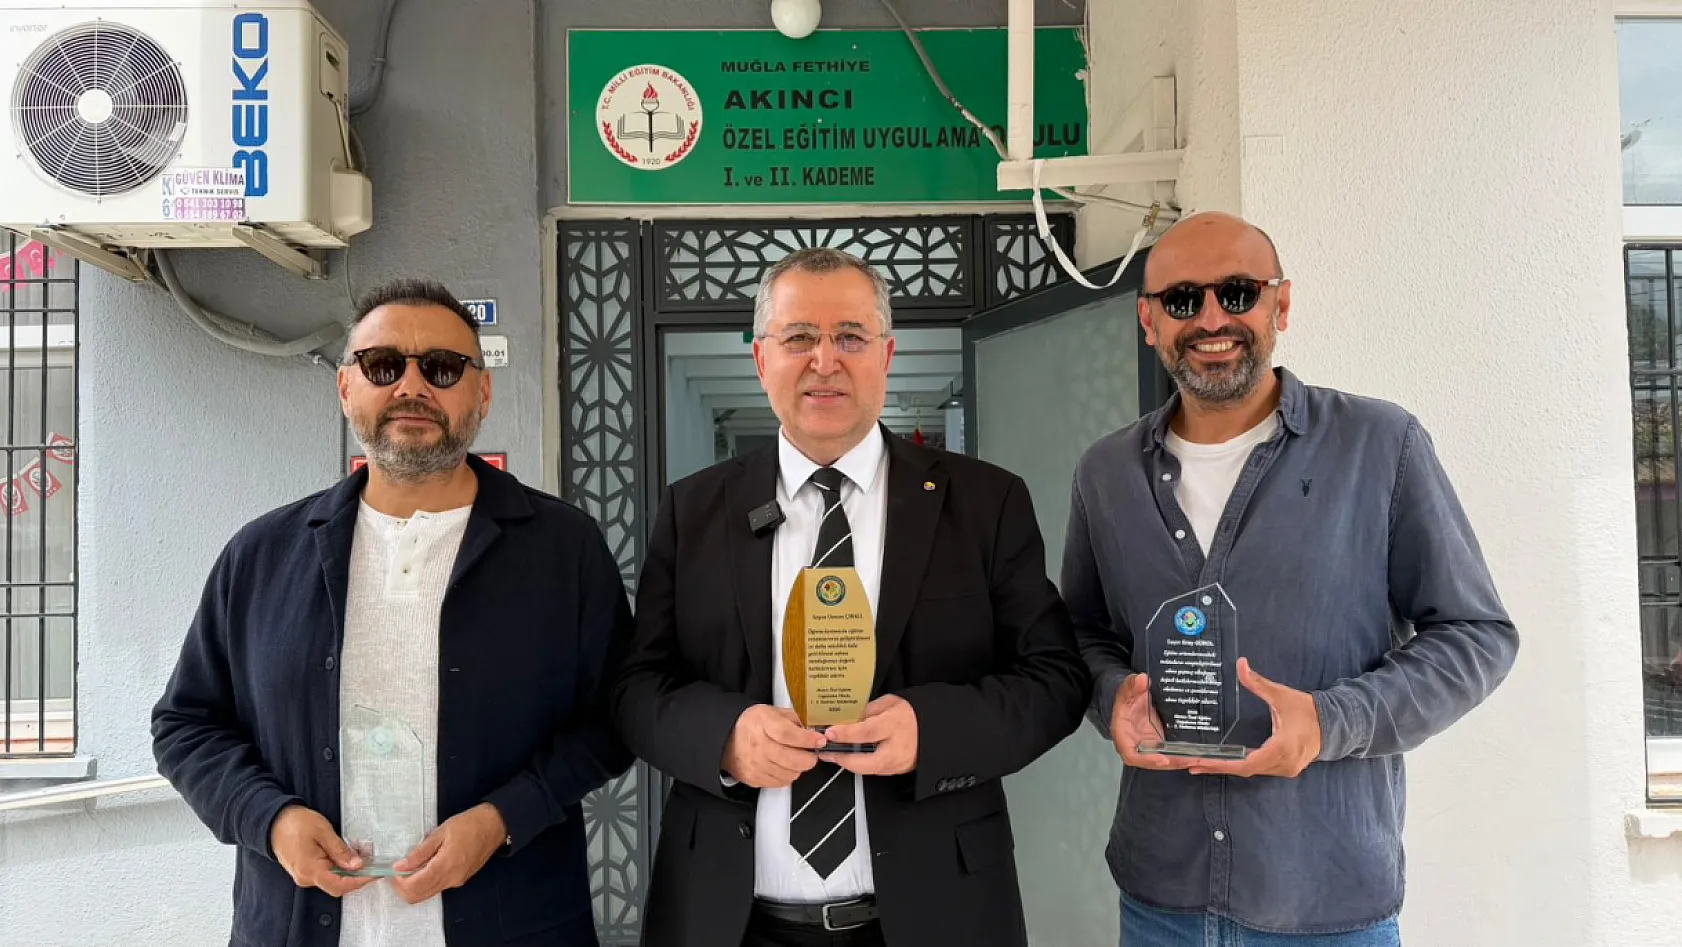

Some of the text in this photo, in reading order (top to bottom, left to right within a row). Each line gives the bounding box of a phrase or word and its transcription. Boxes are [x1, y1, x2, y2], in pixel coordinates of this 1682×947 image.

[721, 58, 870, 72] MUĞLA FETHİYE
[233, 13, 268, 196] BEKO
[724, 90, 854, 109] AKINCI
[722, 123, 775, 149] ÖZEL
[783, 123, 856, 149] EĞİTİM
[176, 169, 245, 185] GÜVEN KLİMA
[724, 167, 875, 186] I. ve II. KADEME
